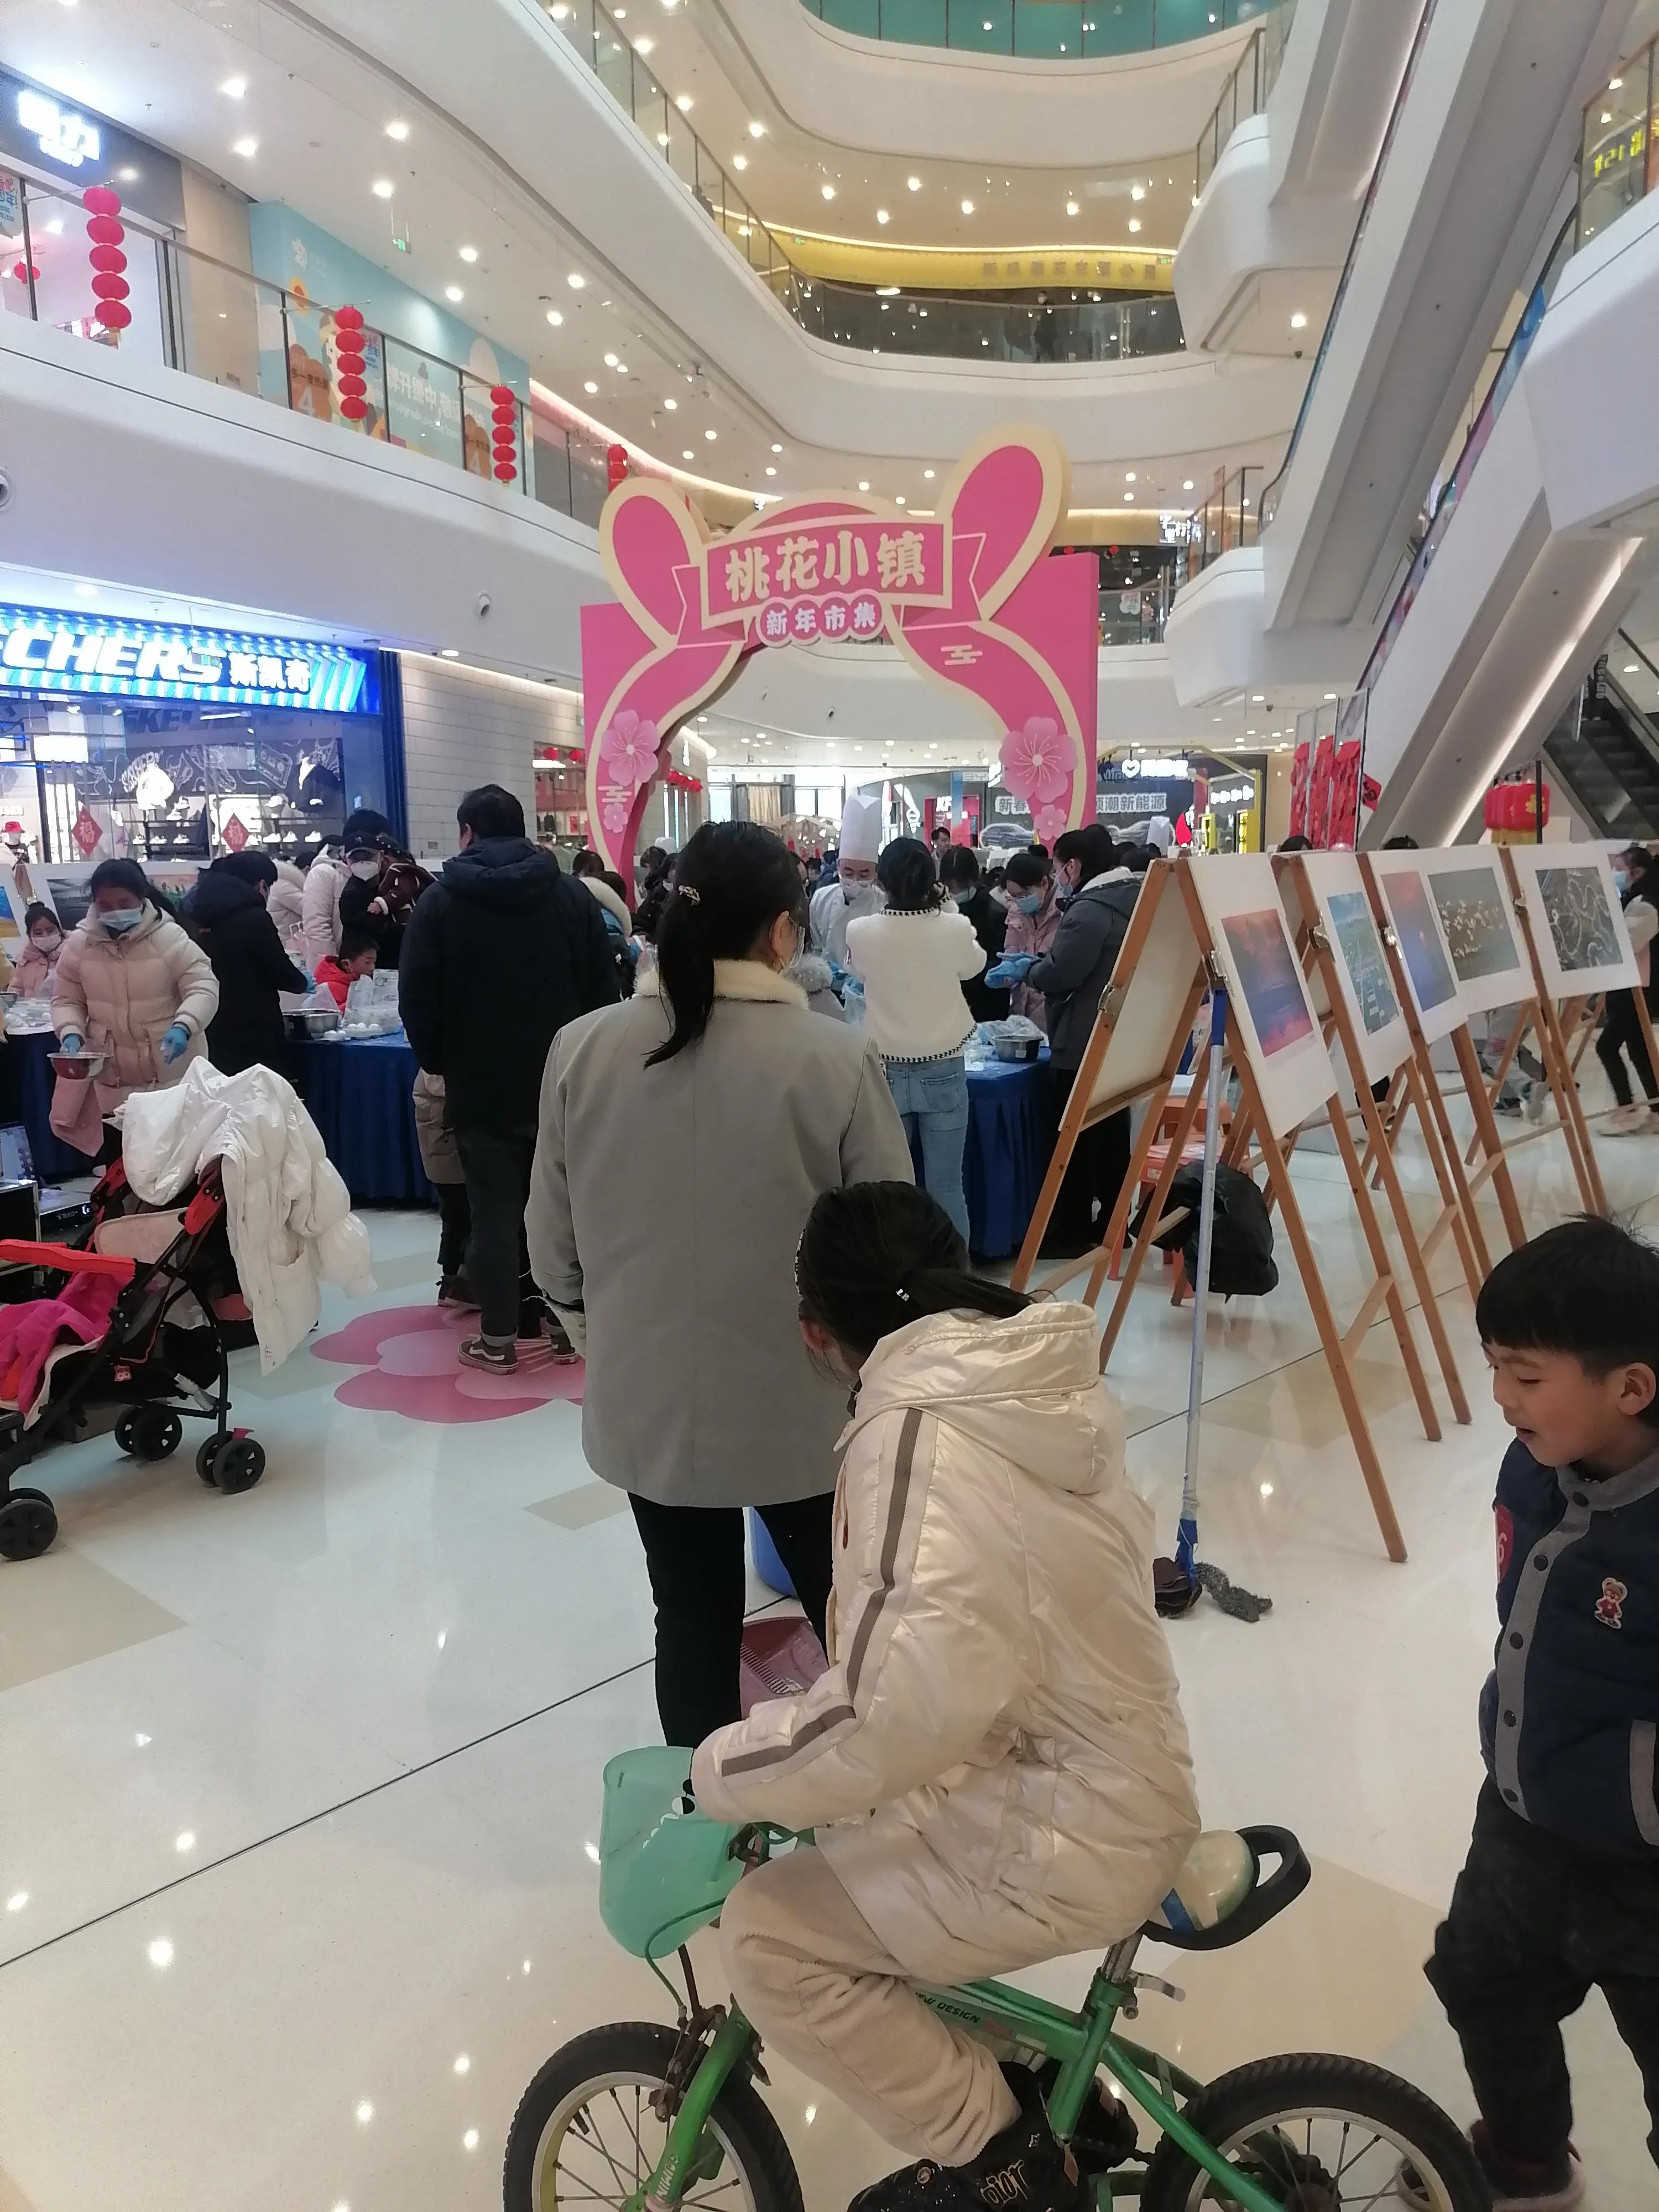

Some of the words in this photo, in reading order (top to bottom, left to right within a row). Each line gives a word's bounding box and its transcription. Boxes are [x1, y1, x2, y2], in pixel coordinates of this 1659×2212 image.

[726, 530, 925, 602] 桃花小镇
[766, 602, 875, 635] 新年市集
[0, 628, 227, 684] CHERS
[228, 652, 310, 691] 斯凯奇
[936, 796, 952, 811] KF
[79, 820, 95, 843] 福
[937, 2002, 981, 2023] DESIGN
